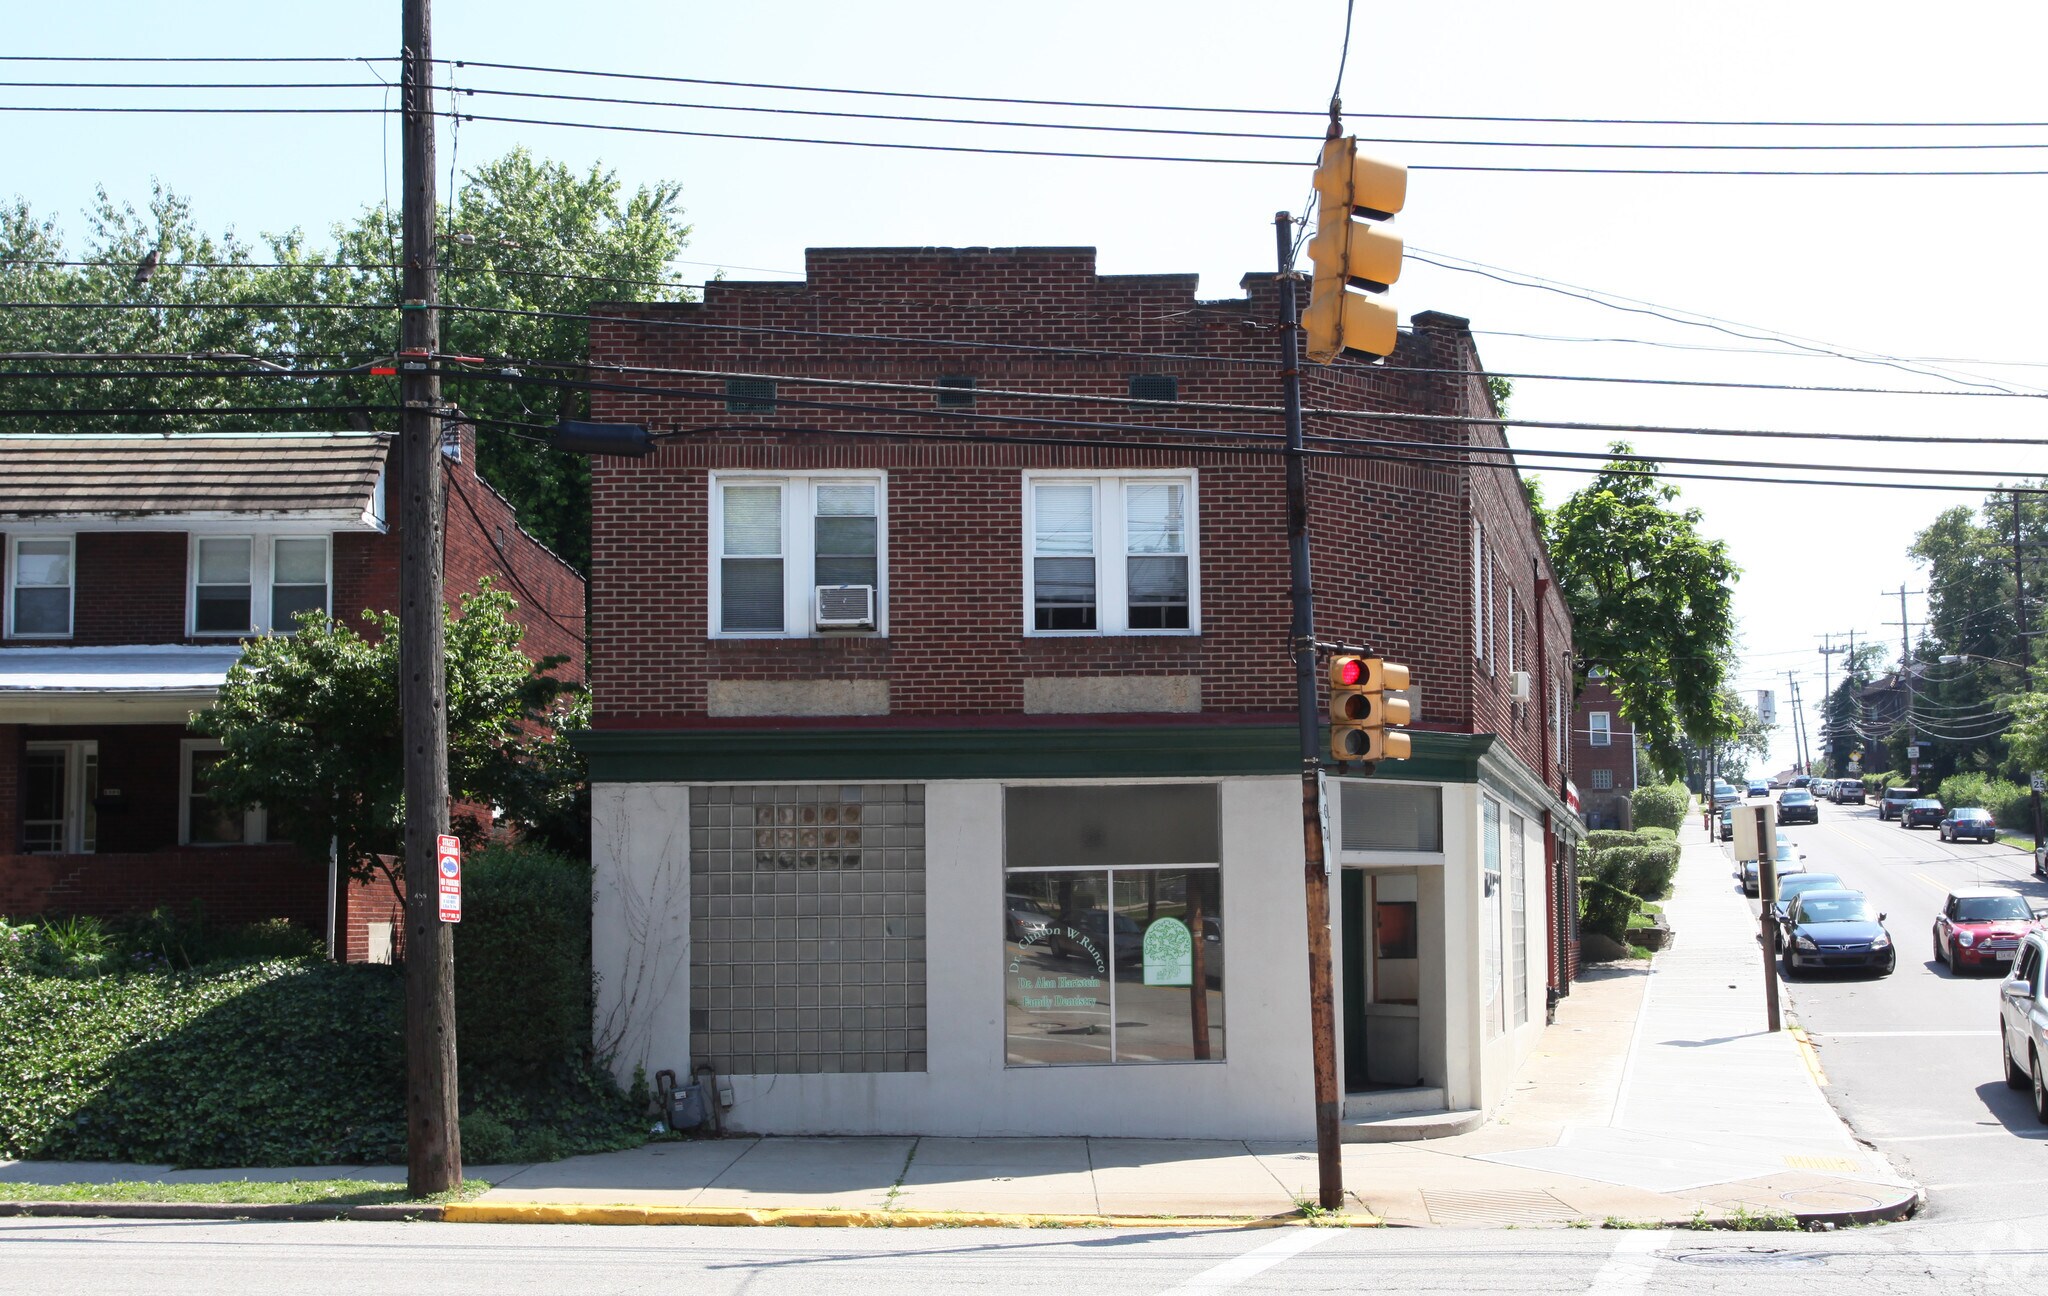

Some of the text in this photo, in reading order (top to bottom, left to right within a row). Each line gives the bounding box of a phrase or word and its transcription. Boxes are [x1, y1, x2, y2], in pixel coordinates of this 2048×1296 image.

[2033, 781, 2046, 789] 25
[1009, 954, 1021, 974] Dr.
[1018, 927, 1061, 950] Clinton
[1080, 935, 1105, 973] Runco
[1018, 977, 1032, 988] Dr.
[1036, 977, 1056, 988] Alan
[1023, 995, 1096, 1008] Family Dentistry
